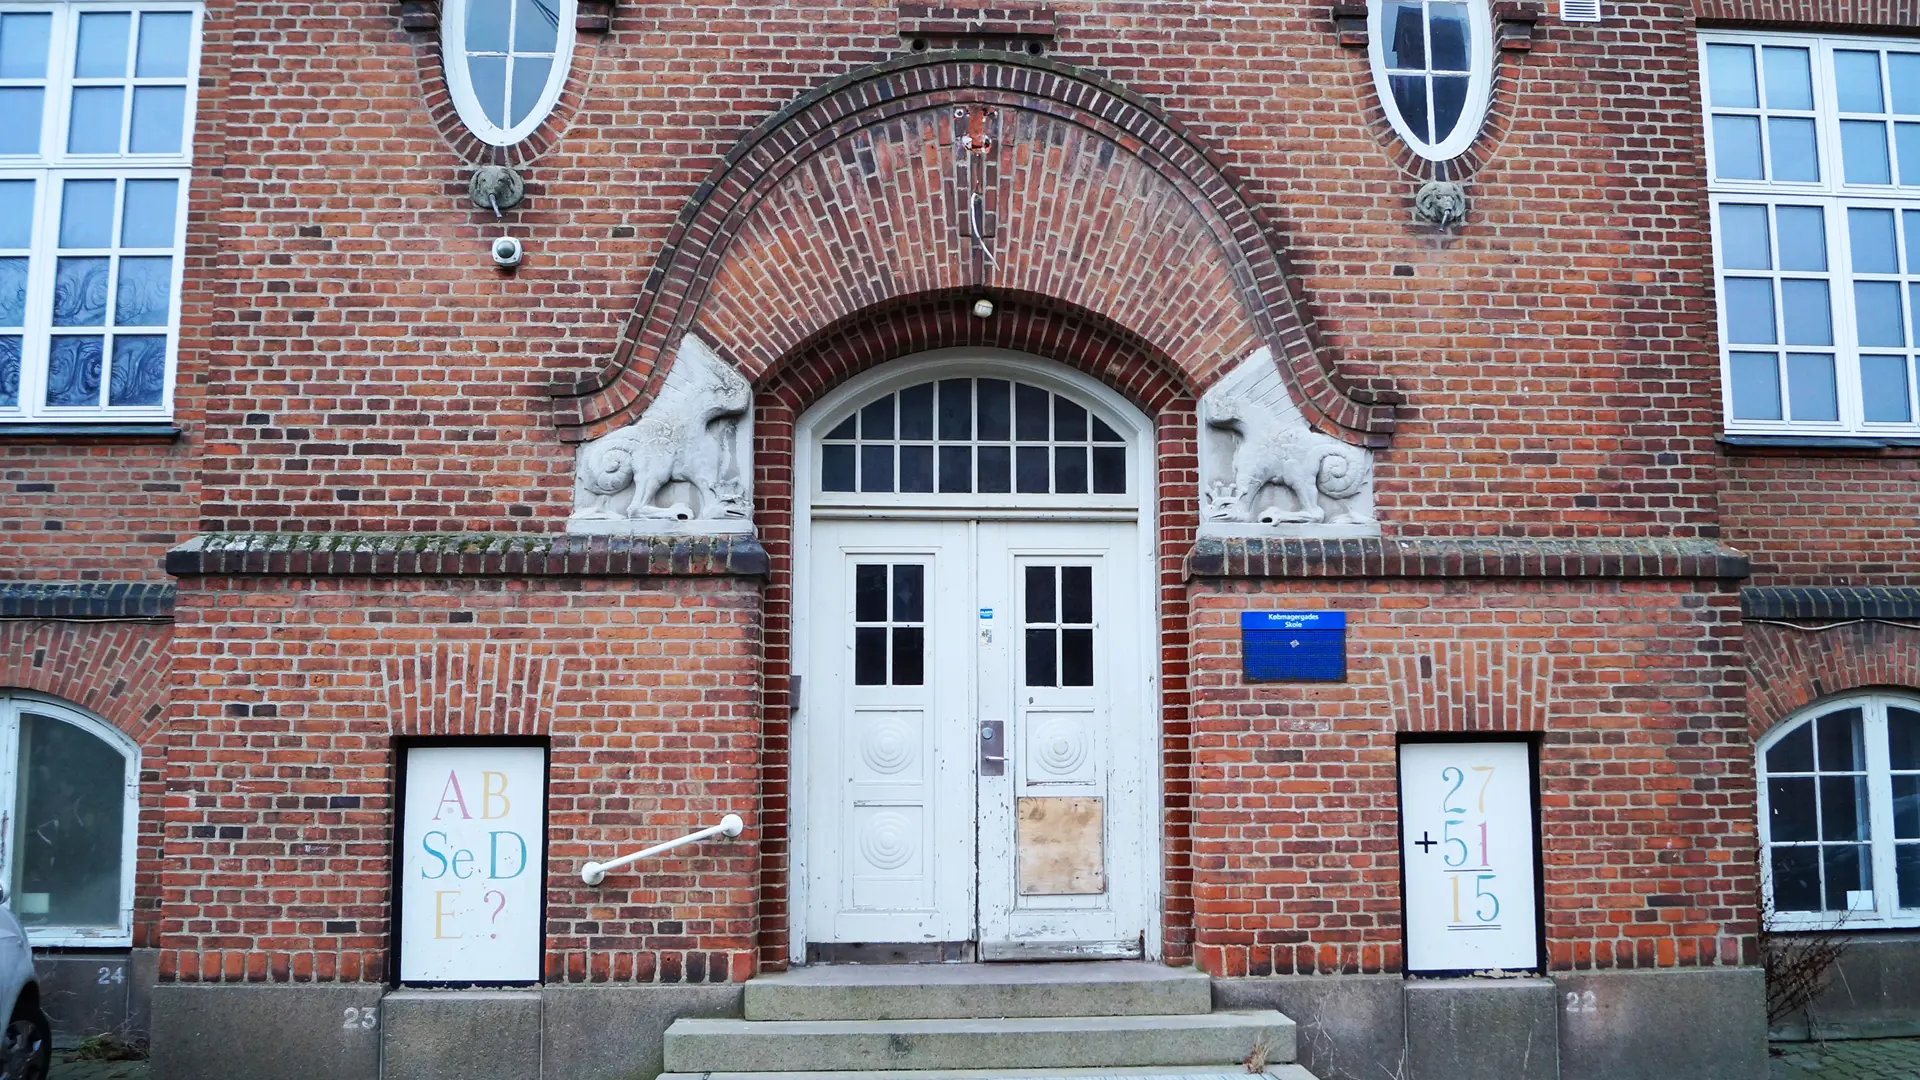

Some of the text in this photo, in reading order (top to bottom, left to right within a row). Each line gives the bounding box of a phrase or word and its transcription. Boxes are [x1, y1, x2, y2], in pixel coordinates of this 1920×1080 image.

[1442, 766, 1495, 813] 27
[1450, 875, 1500, 923] 15
[98, 966, 124, 984] 24
[1566, 990, 1597, 1012] 22
[343, 1007, 376, 1029] 23
